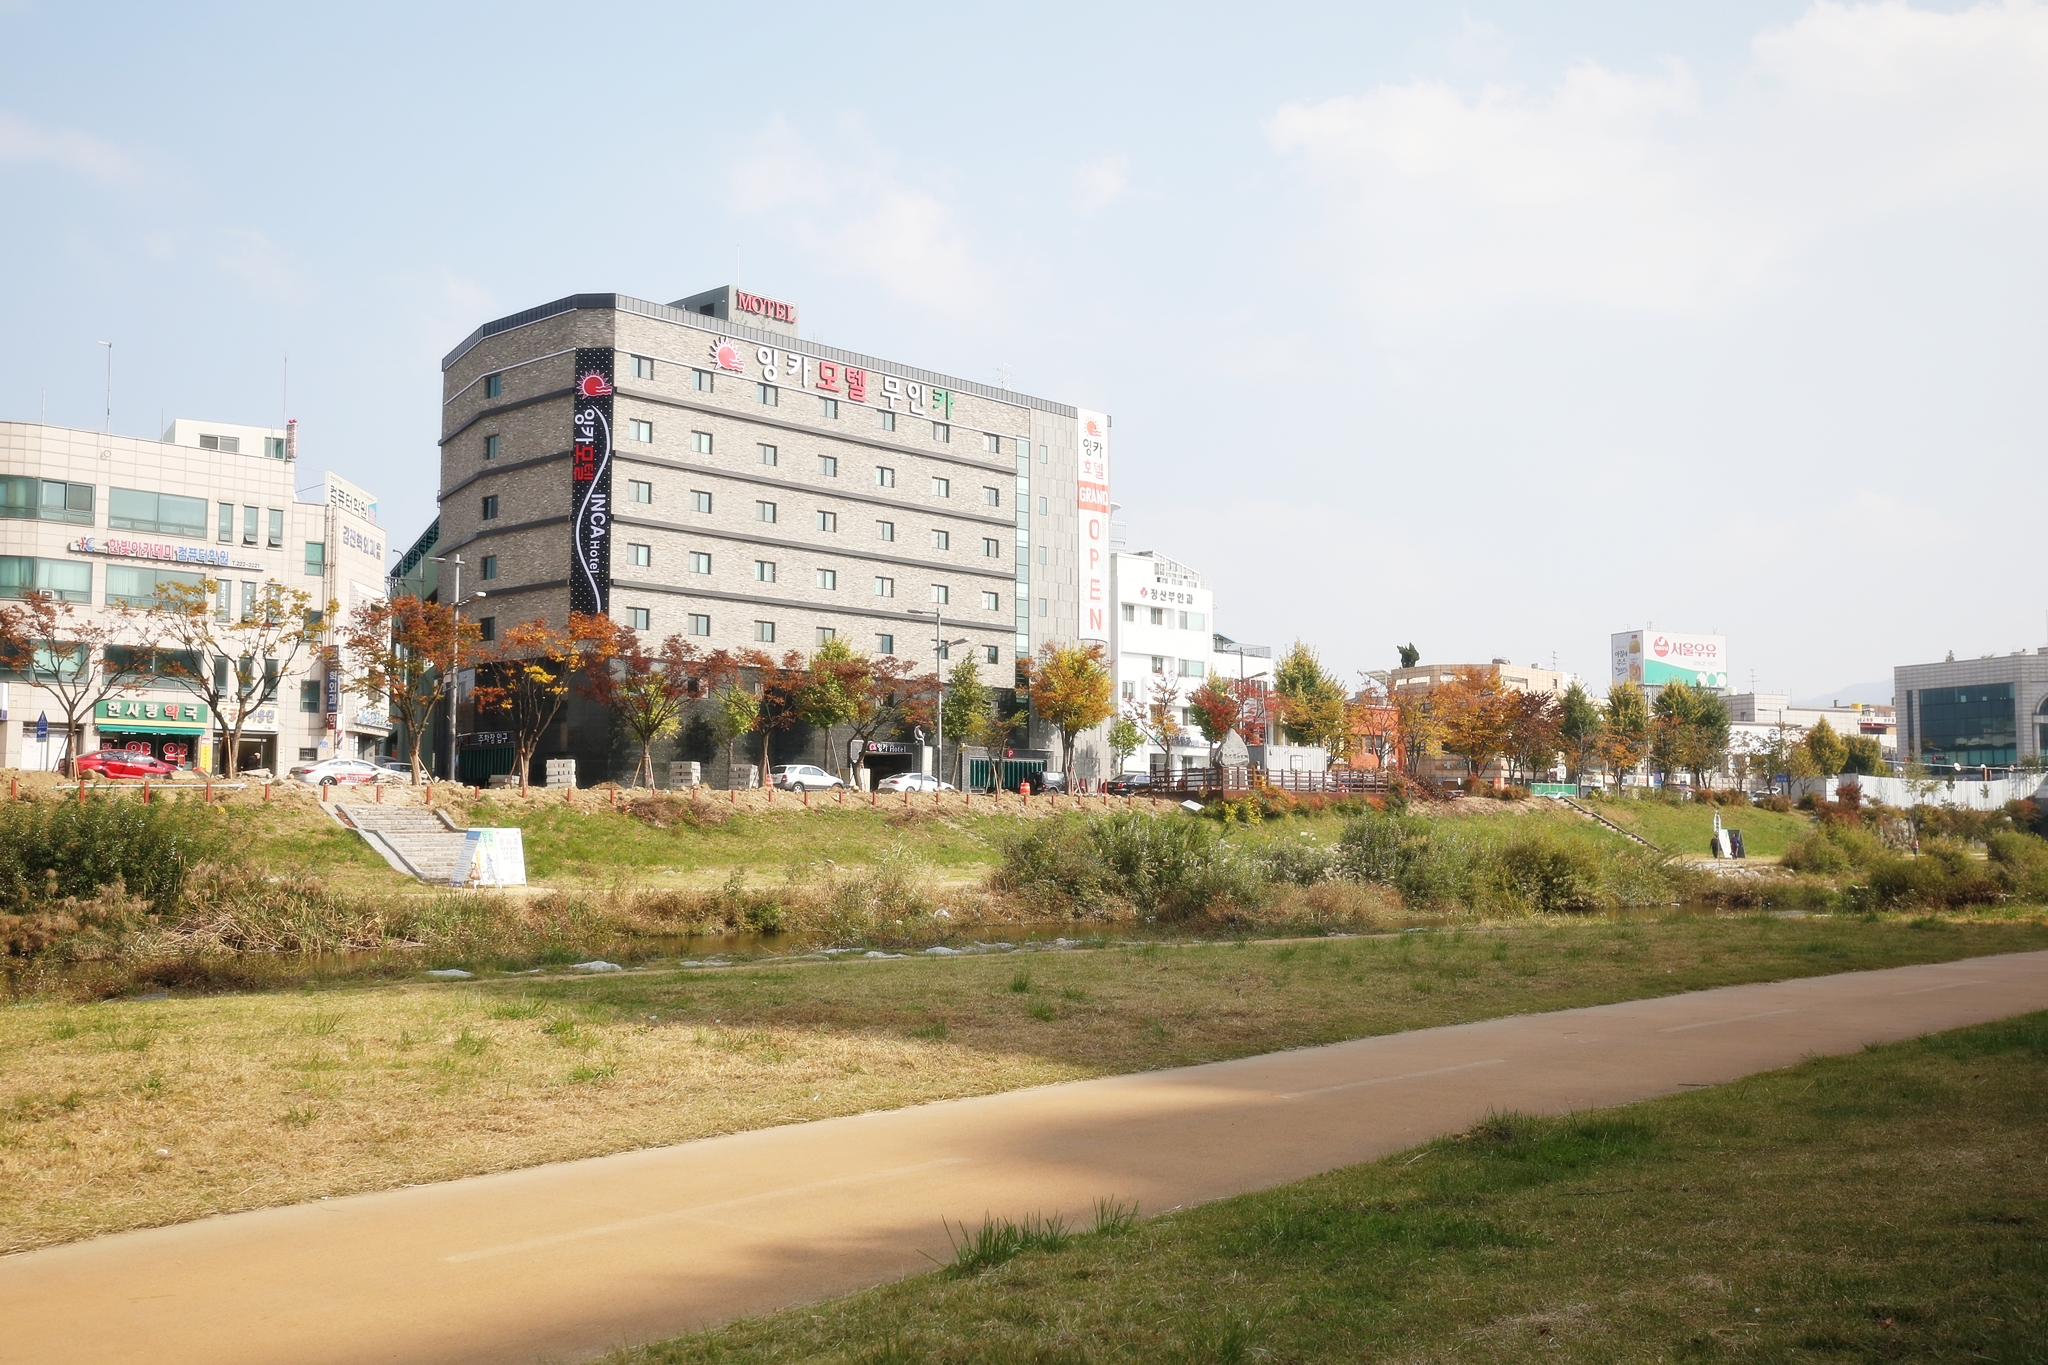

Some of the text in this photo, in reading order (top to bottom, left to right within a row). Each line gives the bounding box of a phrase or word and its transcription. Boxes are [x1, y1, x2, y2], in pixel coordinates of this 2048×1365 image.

[737, 291, 797, 323] MOTEL
[1082, 438, 1103, 459] 잉카
[1083, 459, 1104, 480] 호텔
[330, 484, 368, 520] 컴퓨터학원
[1079, 486, 1109, 506] GRAND
[589, 494, 606, 573] INCA Hotel
[108, 538, 175, 560] 한빛아카데미
[176, 546, 229, 567] 컴퓨터학원
[1088, 518, 1102, 631] OPEN
[1670, 642, 1717, 658] 서울우유
[106, 701, 199, 721] 한사랑약국
